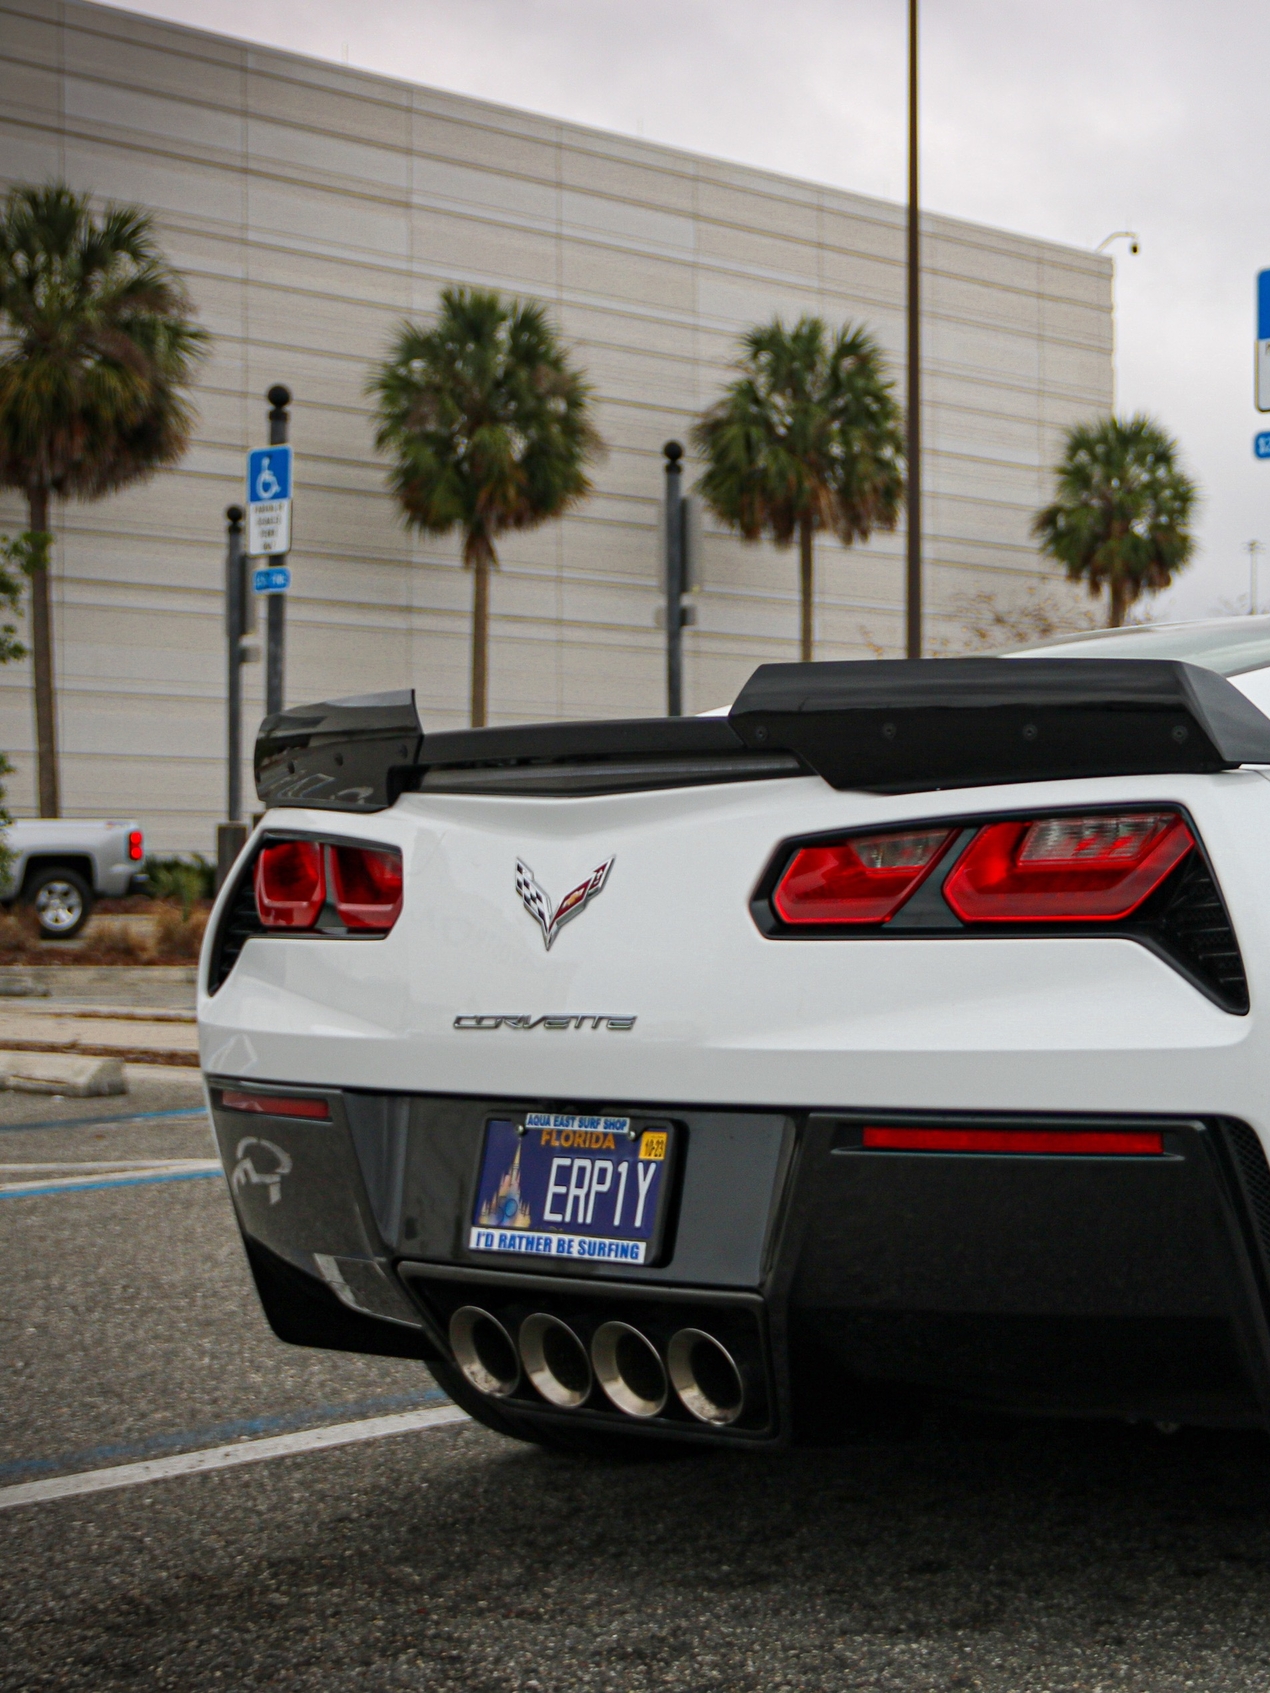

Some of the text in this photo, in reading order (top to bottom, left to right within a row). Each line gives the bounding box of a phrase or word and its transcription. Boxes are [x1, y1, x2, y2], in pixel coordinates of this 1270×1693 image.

[453, 1013, 637, 1030] CORVETTE
[527, 1115, 627, 1130] AQUA EAST SURF SHOP
[541, 1129, 616, 1149] FLORIDA
[543, 1157, 656, 1228] ERP1Y
[476, 1231, 639, 1260] I'D RATHER BE SURFING
